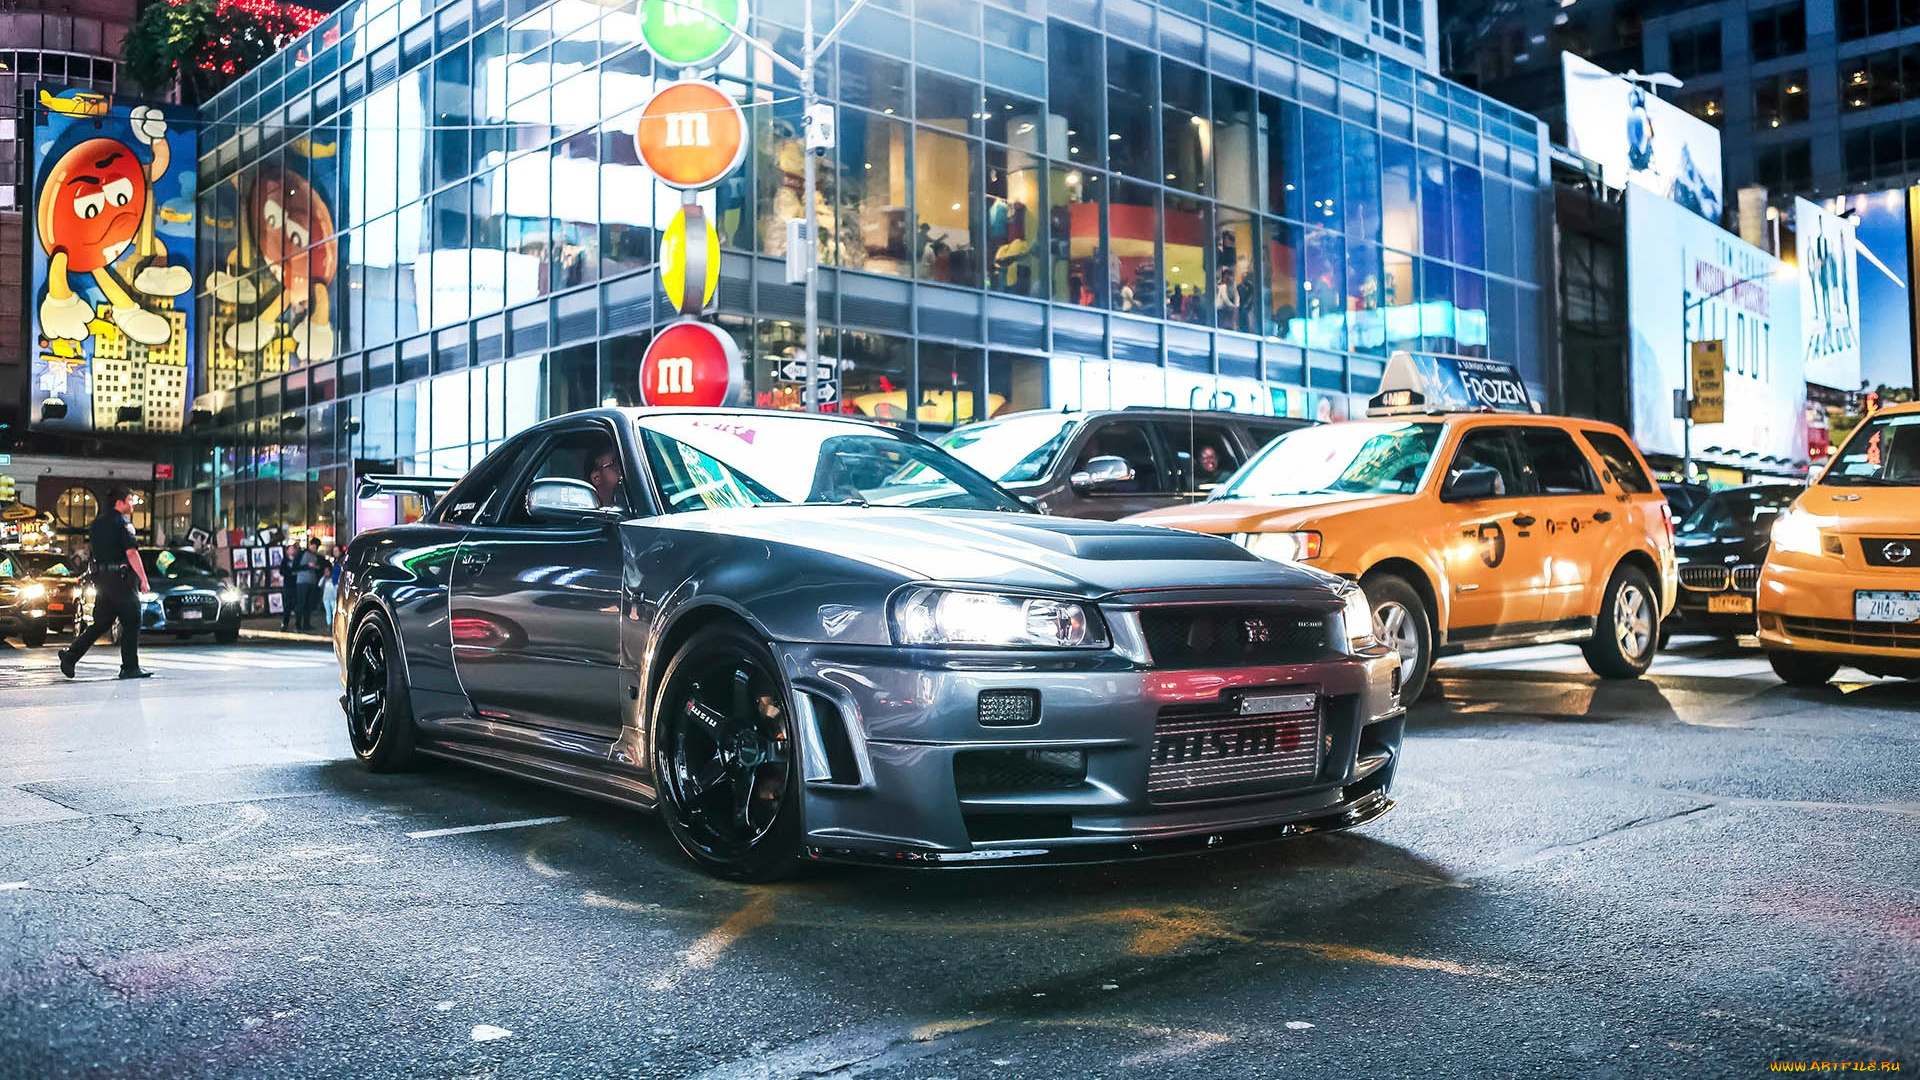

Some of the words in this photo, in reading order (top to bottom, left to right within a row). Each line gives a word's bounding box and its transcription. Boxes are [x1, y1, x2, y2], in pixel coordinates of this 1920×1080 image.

[665, 112, 710, 147] m
[657, 357, 695, 394] m
[1458, 370, 1527, 408] FROZEN
